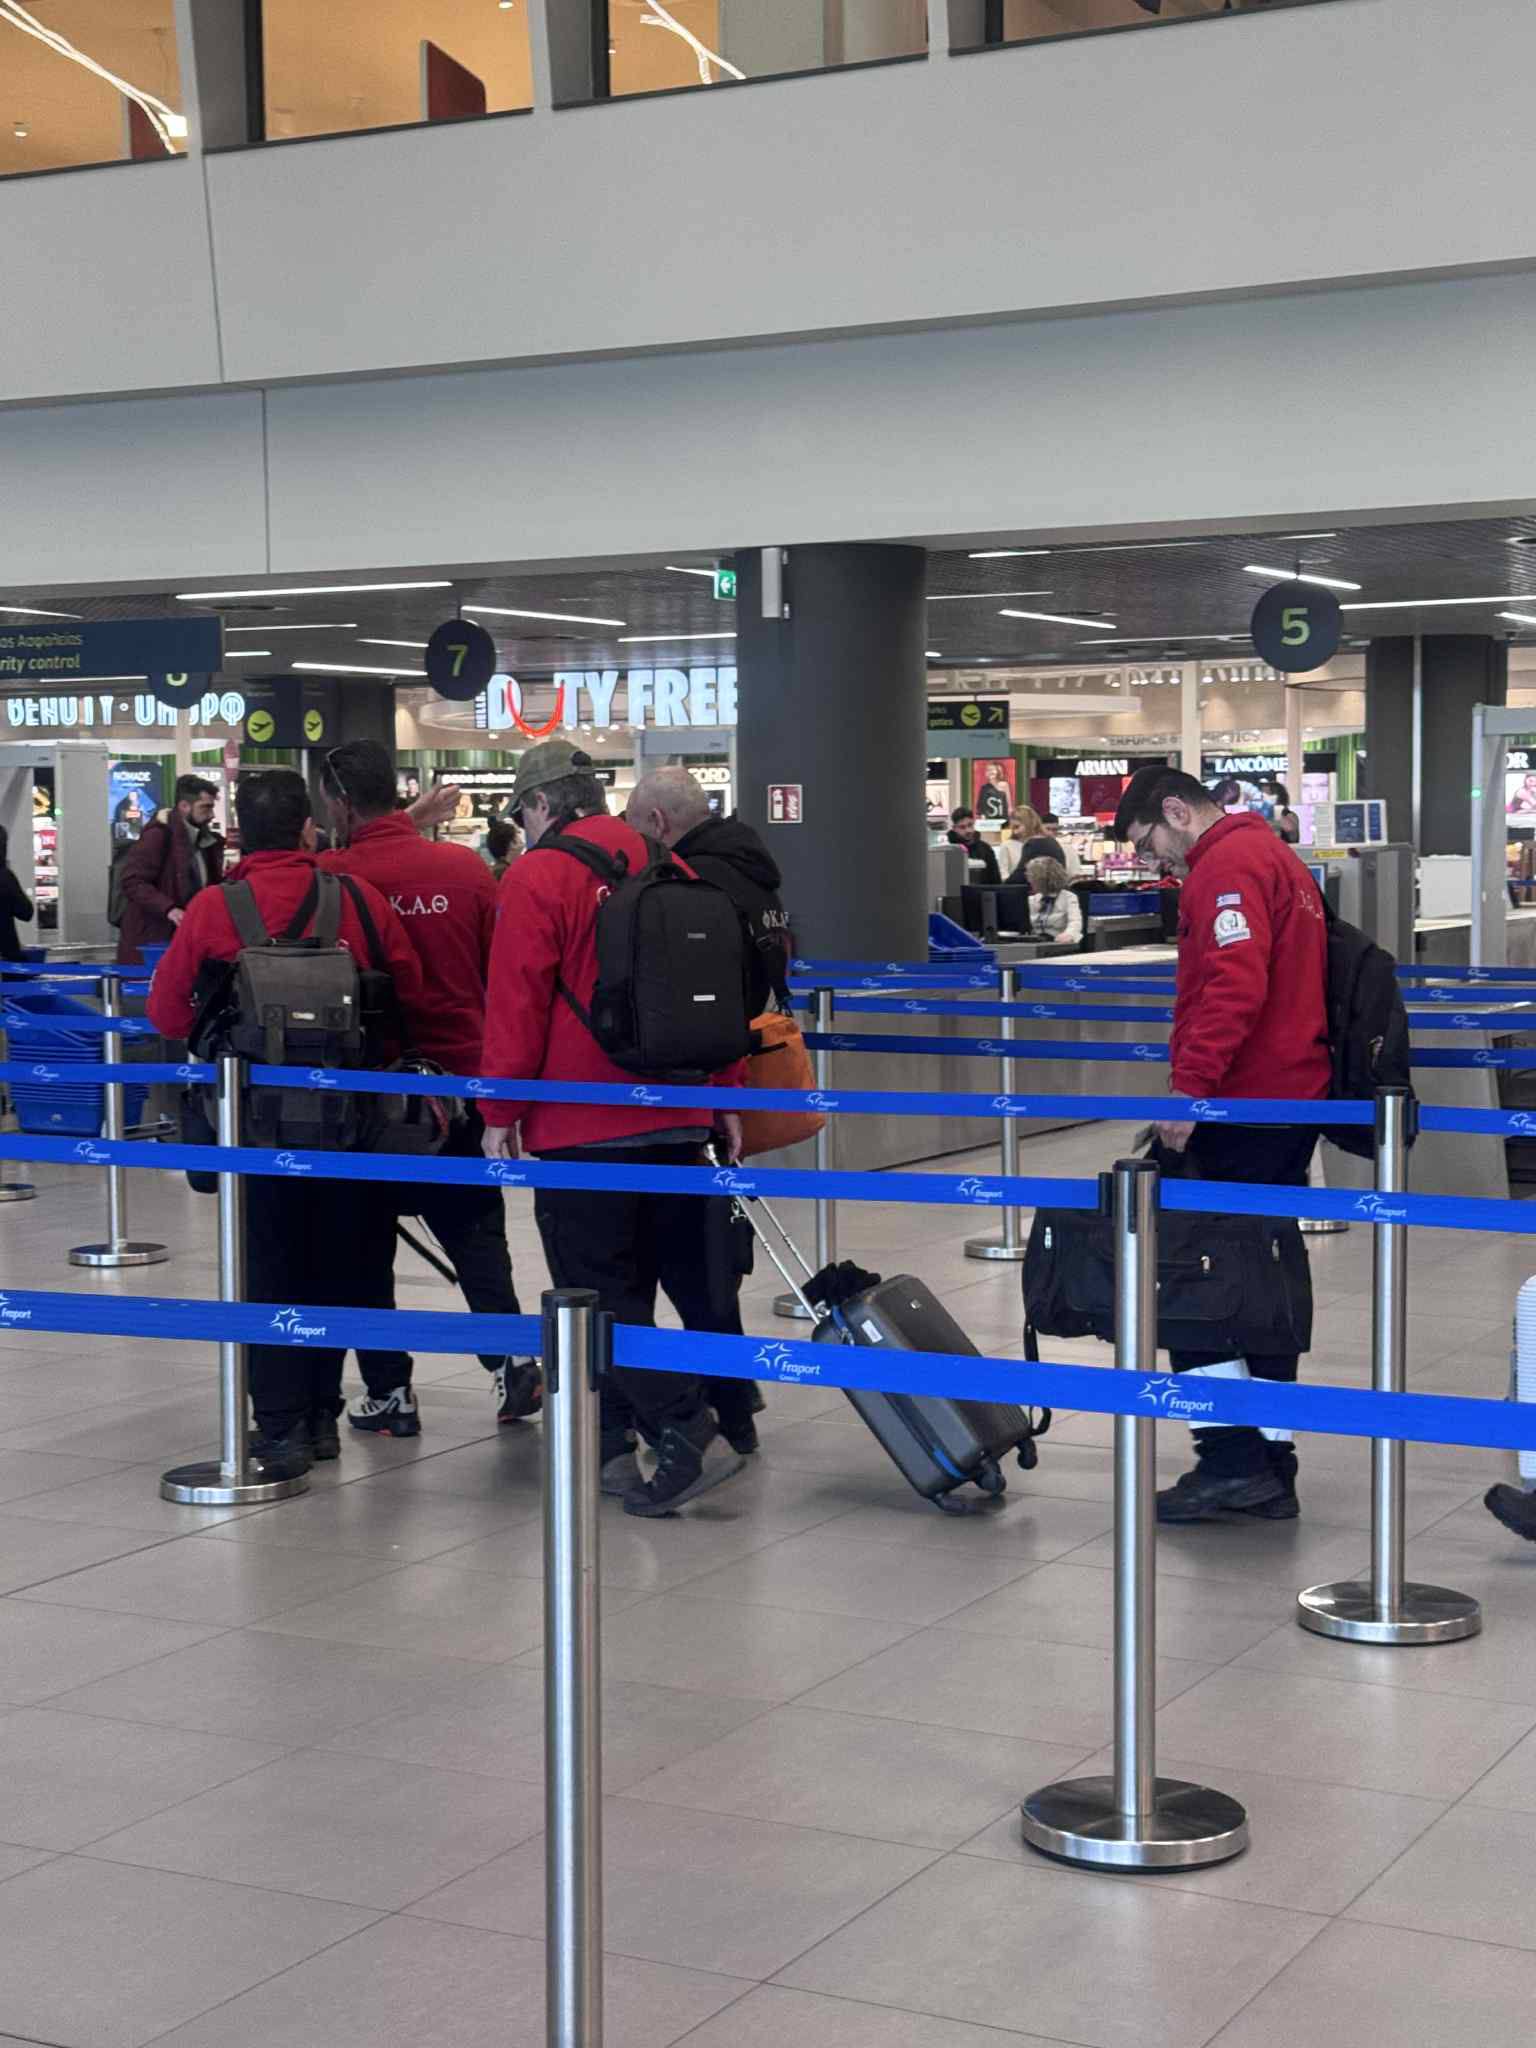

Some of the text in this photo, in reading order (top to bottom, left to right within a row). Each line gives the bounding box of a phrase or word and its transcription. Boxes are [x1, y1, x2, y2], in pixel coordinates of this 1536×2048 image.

[1281, 608, 1309, 646] 5
[28, 653, 80, 670] control
[448, 645, 467, 677] 7
[488, 671, 618, 736] DUTY
[627, 667, 737, 727] FREE
[1075, 760, 1128, 775] ARMANI
